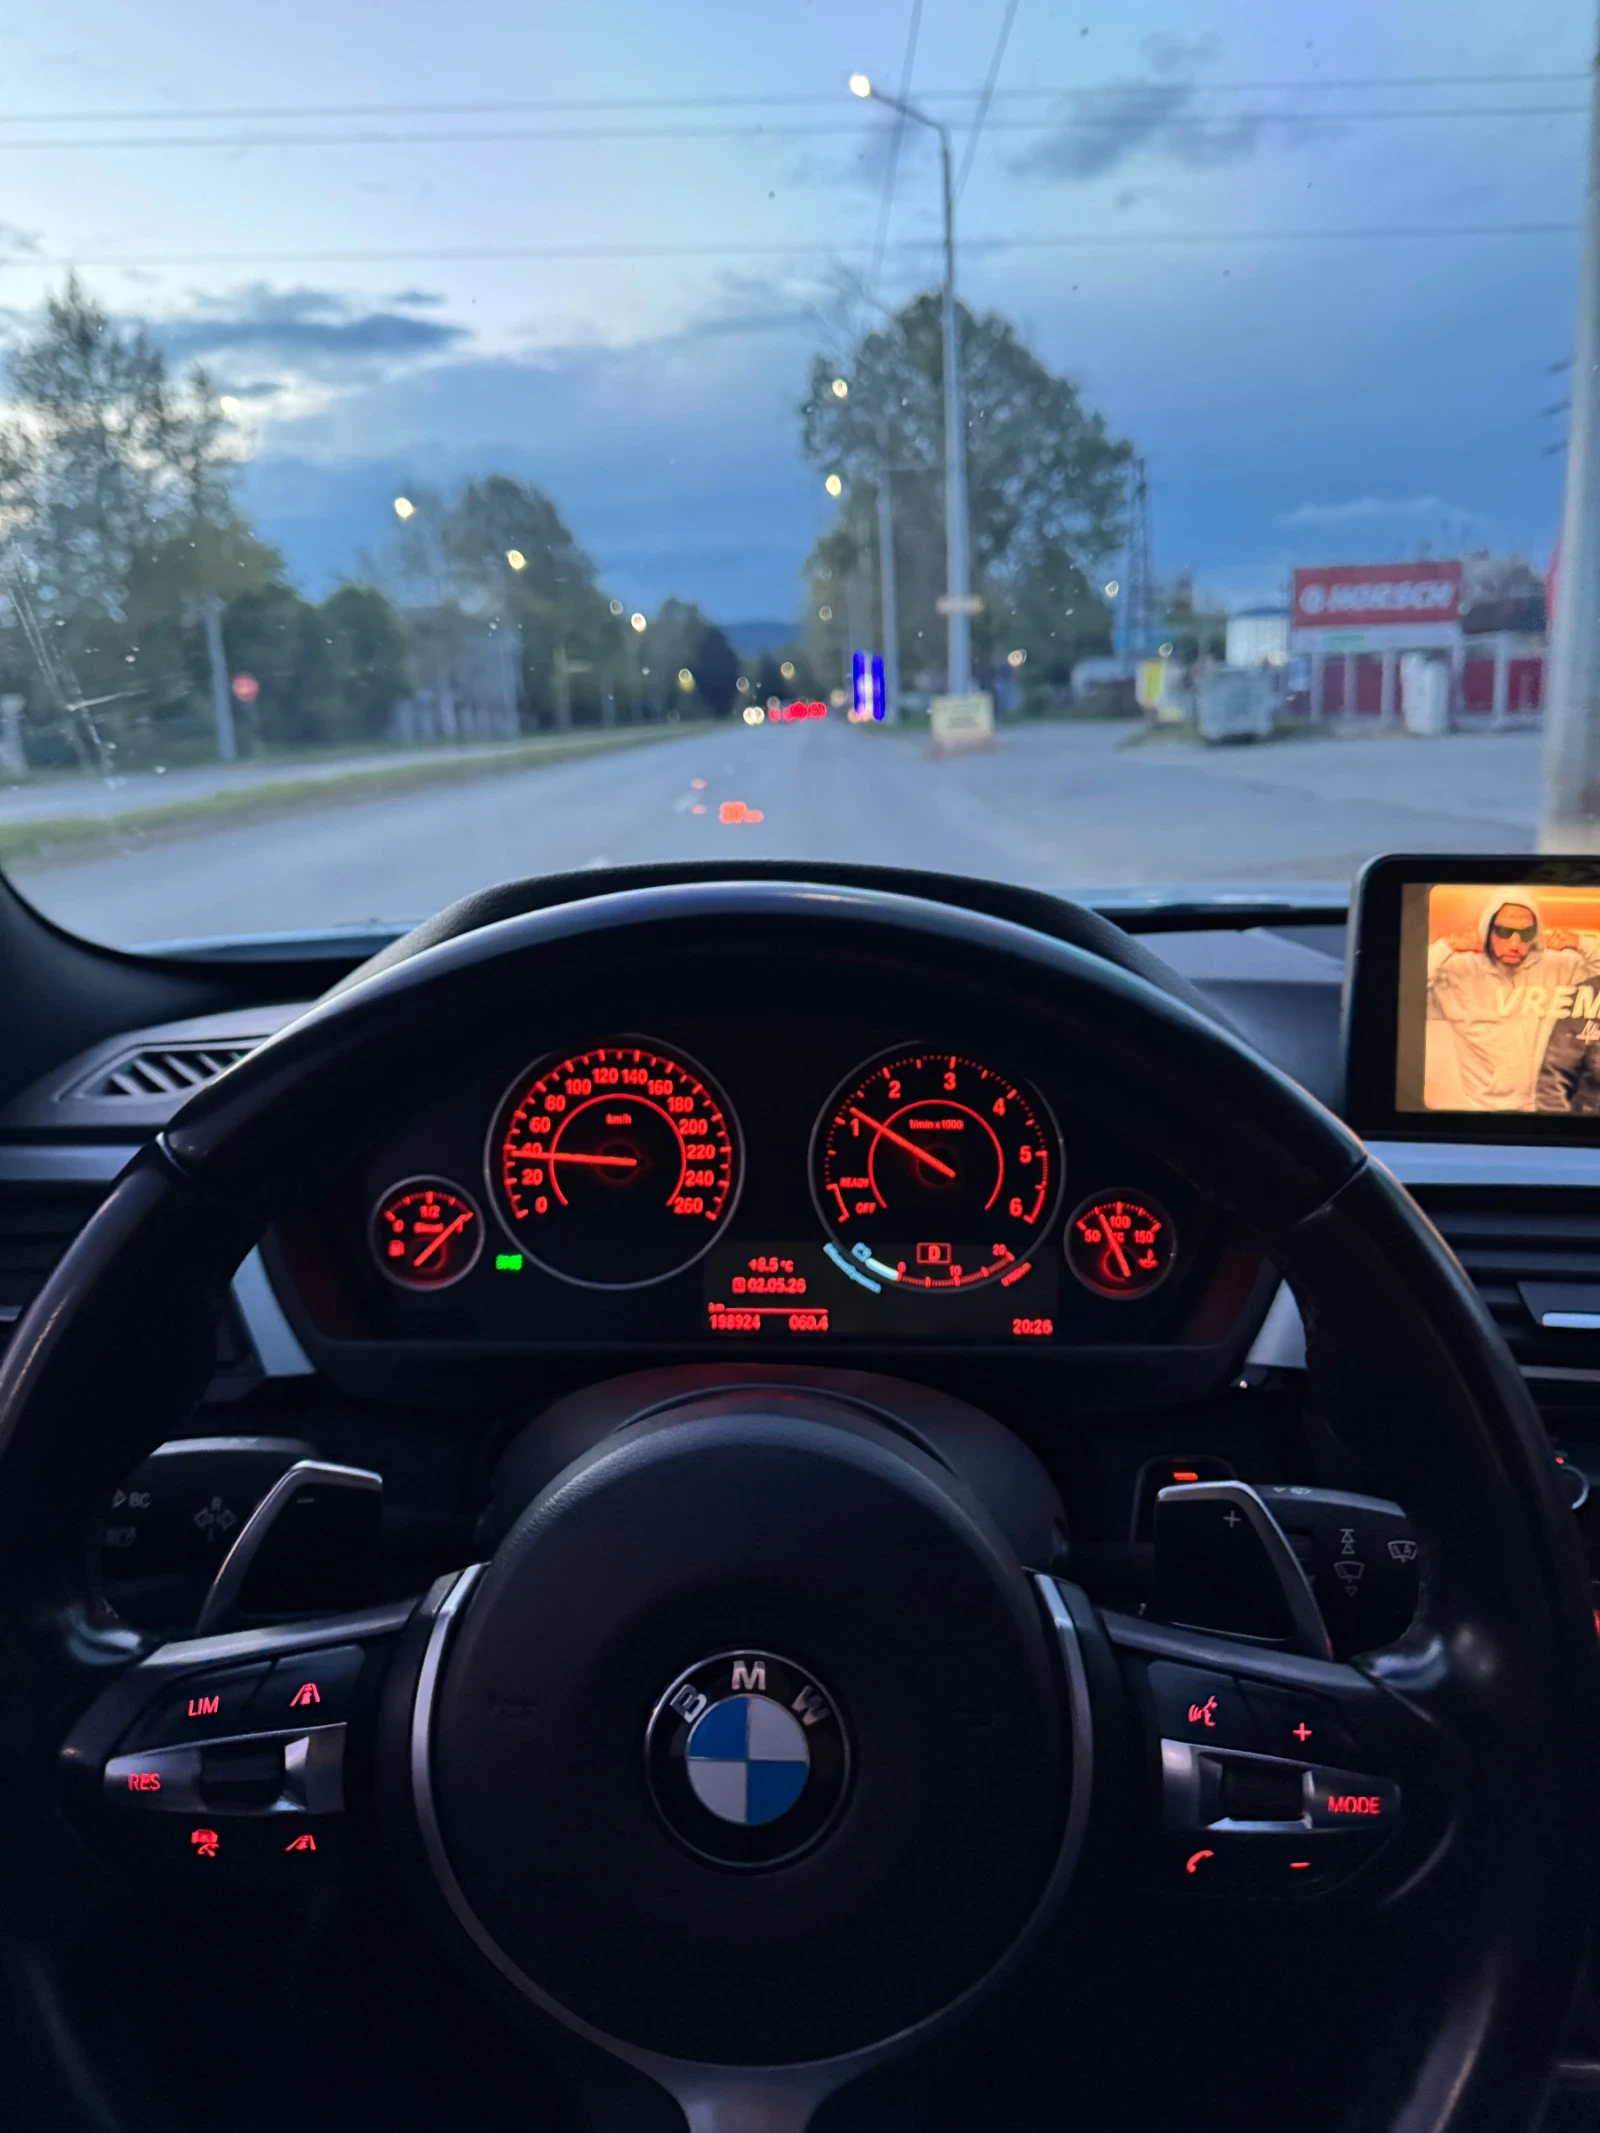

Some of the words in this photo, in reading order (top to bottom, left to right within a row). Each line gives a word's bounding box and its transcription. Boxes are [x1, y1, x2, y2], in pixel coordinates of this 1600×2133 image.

[592, 1068, 619, 1085] 120
[621, 1068, 648, 1085] 140
[944, 1072, 957, 1091] 3
[564, 1079, 592, 1096] 100
[647, 1079, 674, 1096] 160
[888, 1080, 902, 1099] 2
[544, 1094, 566, 1112] 80
[666, 1096, 694, 1113] 180
[992, 1098, 1006, 1117] 4
[528, 1116, 551, 1134] 60
[678, 1118, 709, 1136] 200
[850, 1118, 860, 1138] 1
[942, 1119, 965, 1131] 1000
[520, 1142, 543, 1156] 40
[686, 1144, 716, 1160] 220
[1019, 1145, 1033, 1165] 5
[521, 1168, 544, 1187] 20
[684, 1169, 715, 1188] 240
[535, 1196, 548, 1214] 0
[673, 1196, 704, 1215] 260
[855, 1202, 877, 1215] OFF
[1009, 1197, 1024, 1218] 6
[392, 1219, 405, 1234] 0
[1109, 1215, 1132, 1229] 100
[1084, 1229, 1102, 1243] 50
[1133, 1229, 1155, 1244] 150
[928, 1245, 940, 1262] D
[992, 1243, 1007, 1256] 20
[949, 1264, 962, 1277] 10
[1012, 1318, 1053, 1335] 20:26
[670, 1660, 829, 1726] BMW
[188, 1696, 219, 1717] LIM
[128, 1773, 161, 1791] RES
[1327, 1796, 1381, 1815] MODE
